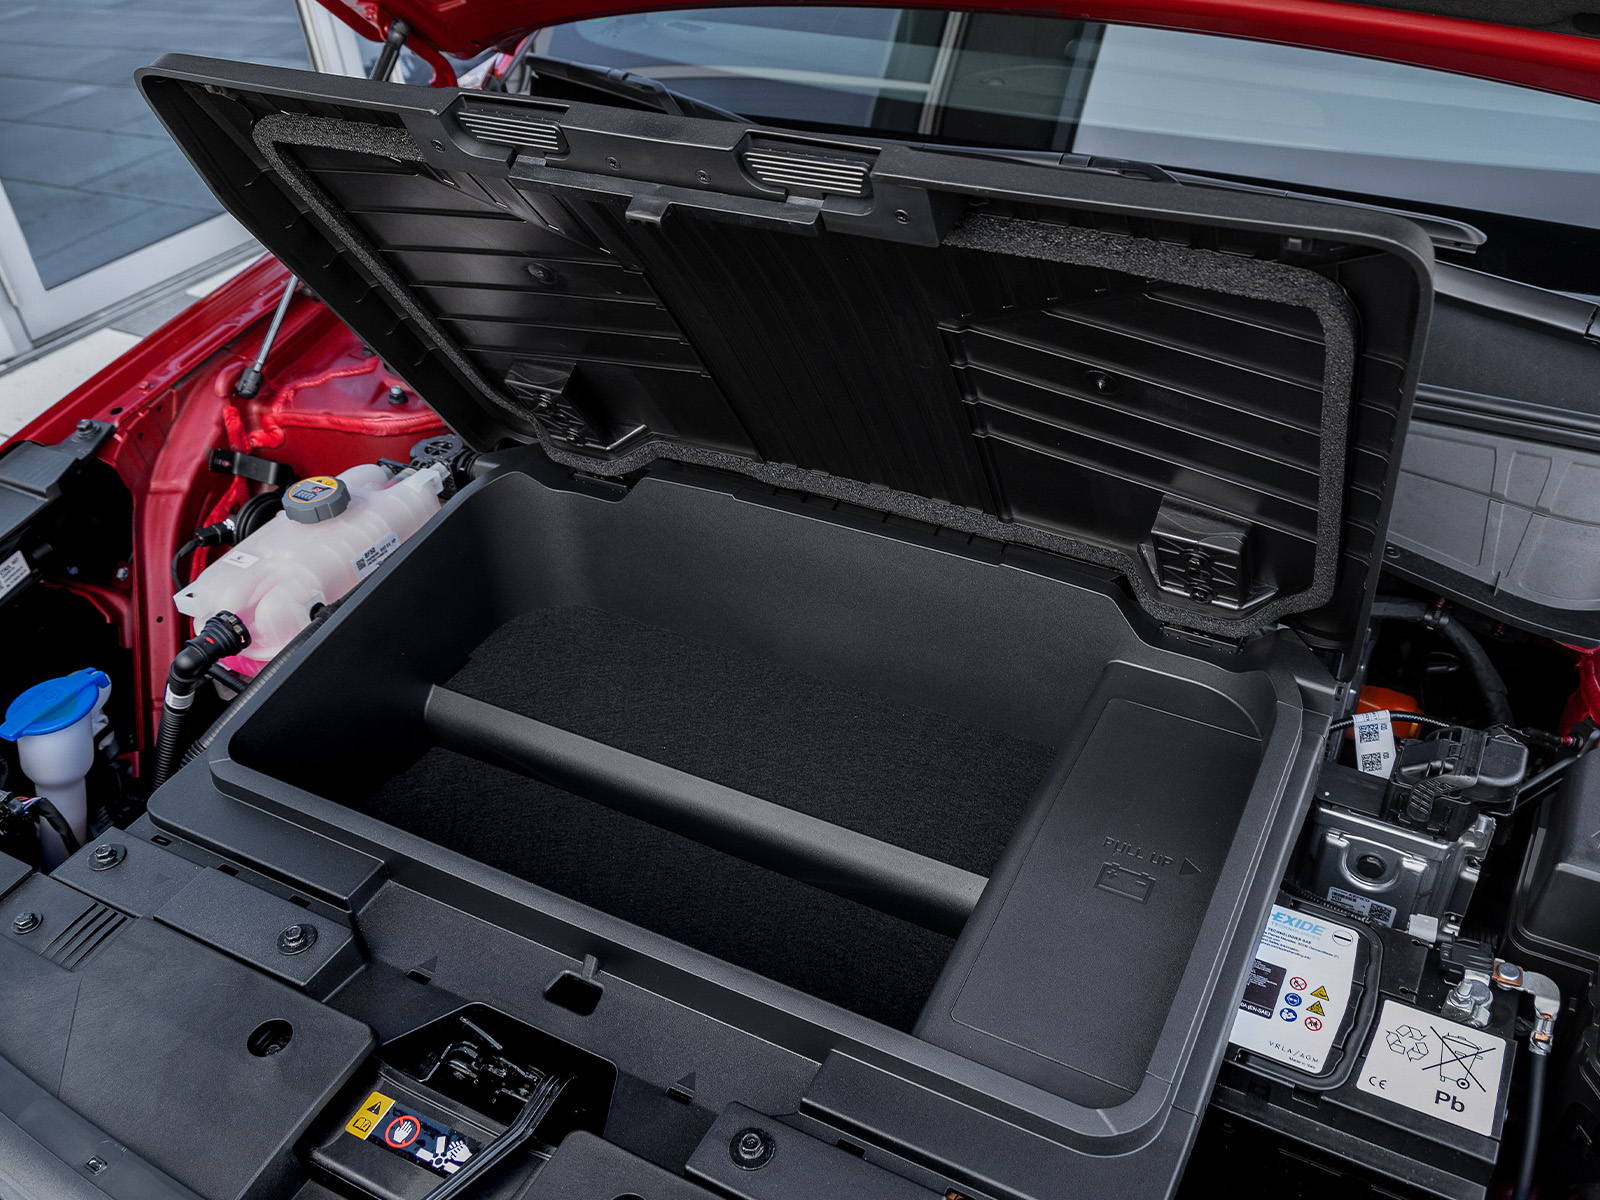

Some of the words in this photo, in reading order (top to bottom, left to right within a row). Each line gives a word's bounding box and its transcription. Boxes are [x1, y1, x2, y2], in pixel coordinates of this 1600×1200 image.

[1102, 836, 1143, 860] PULL
[1149, 852, 1174, 867] UP
[1271, 911, 1327, 936] EXIDE
[1271, 921, 1320, 941] TECHNOLOGIES
[1434, 1090, 1466, 1113] Pb
